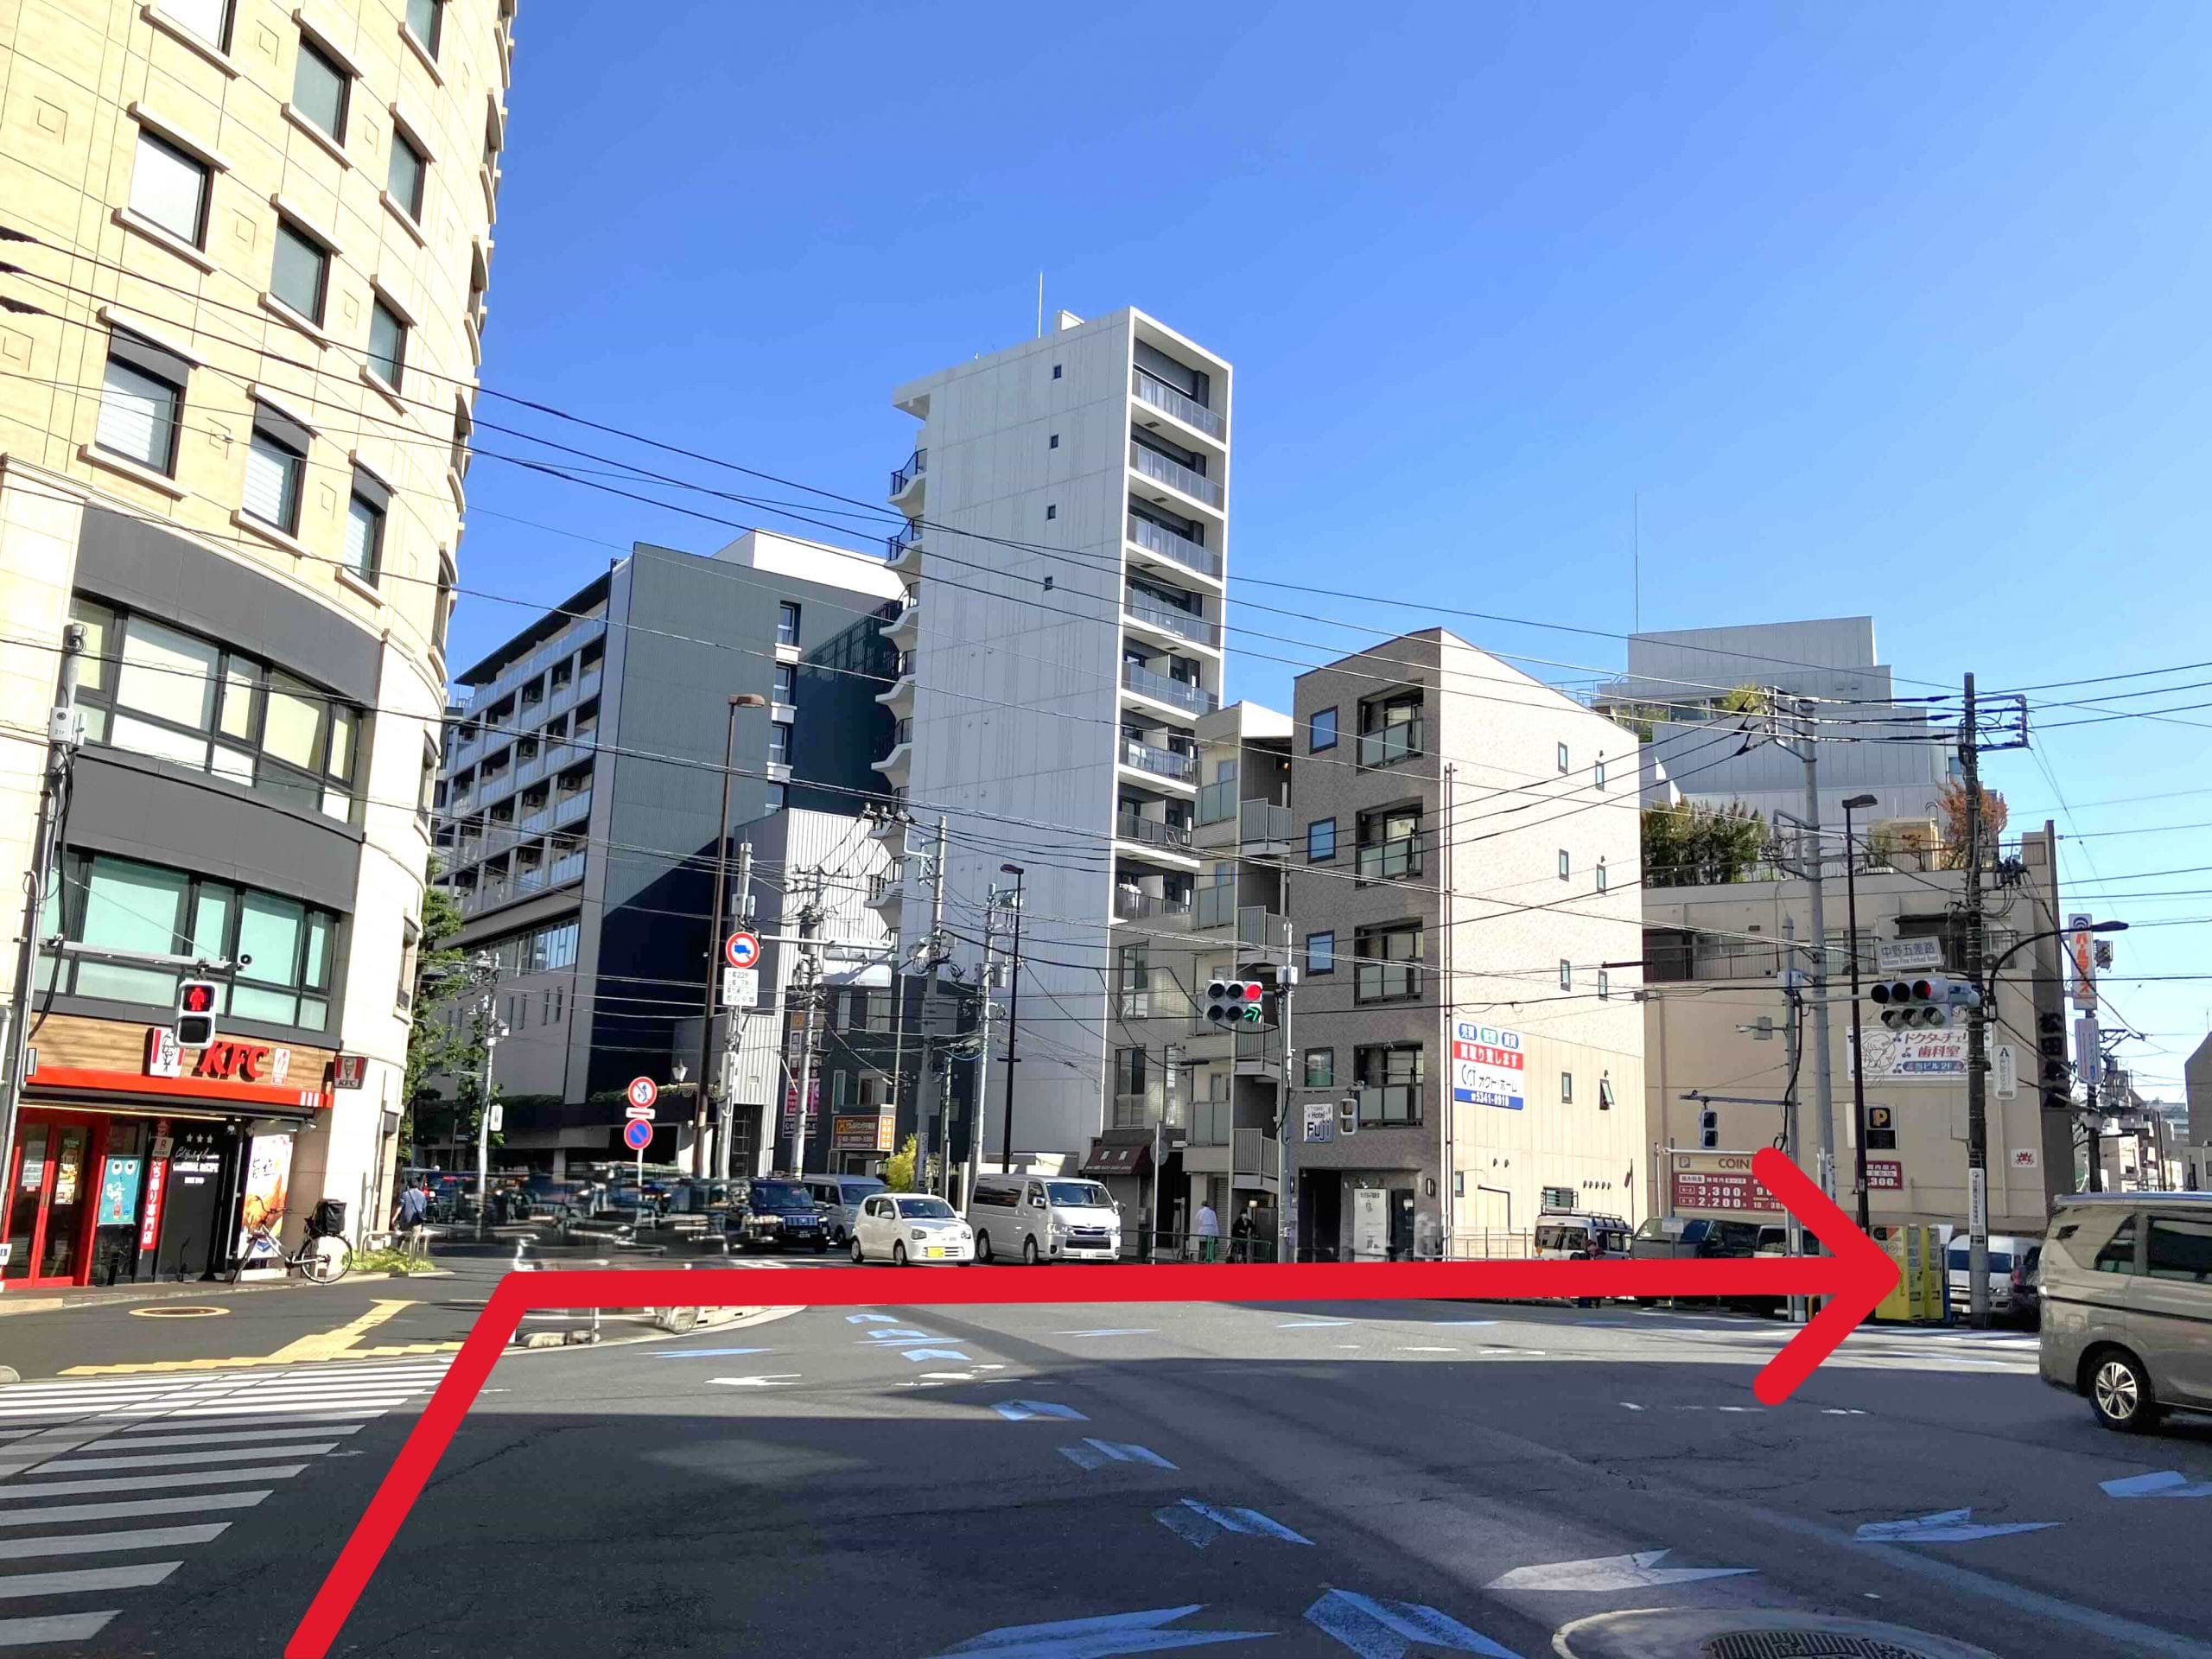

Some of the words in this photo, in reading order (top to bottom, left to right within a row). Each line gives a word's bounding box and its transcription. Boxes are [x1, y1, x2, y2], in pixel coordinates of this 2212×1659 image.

[1905, 1031, 1968, 1046] ドクターチェ
[200, 1039, 270, 1078] KFC
[1918, 1046, 1960, 1058] 歯科室
[1307, 1120, 1330, 1141] Fuji
[1719, 1158, 1750, 1169] COIN
